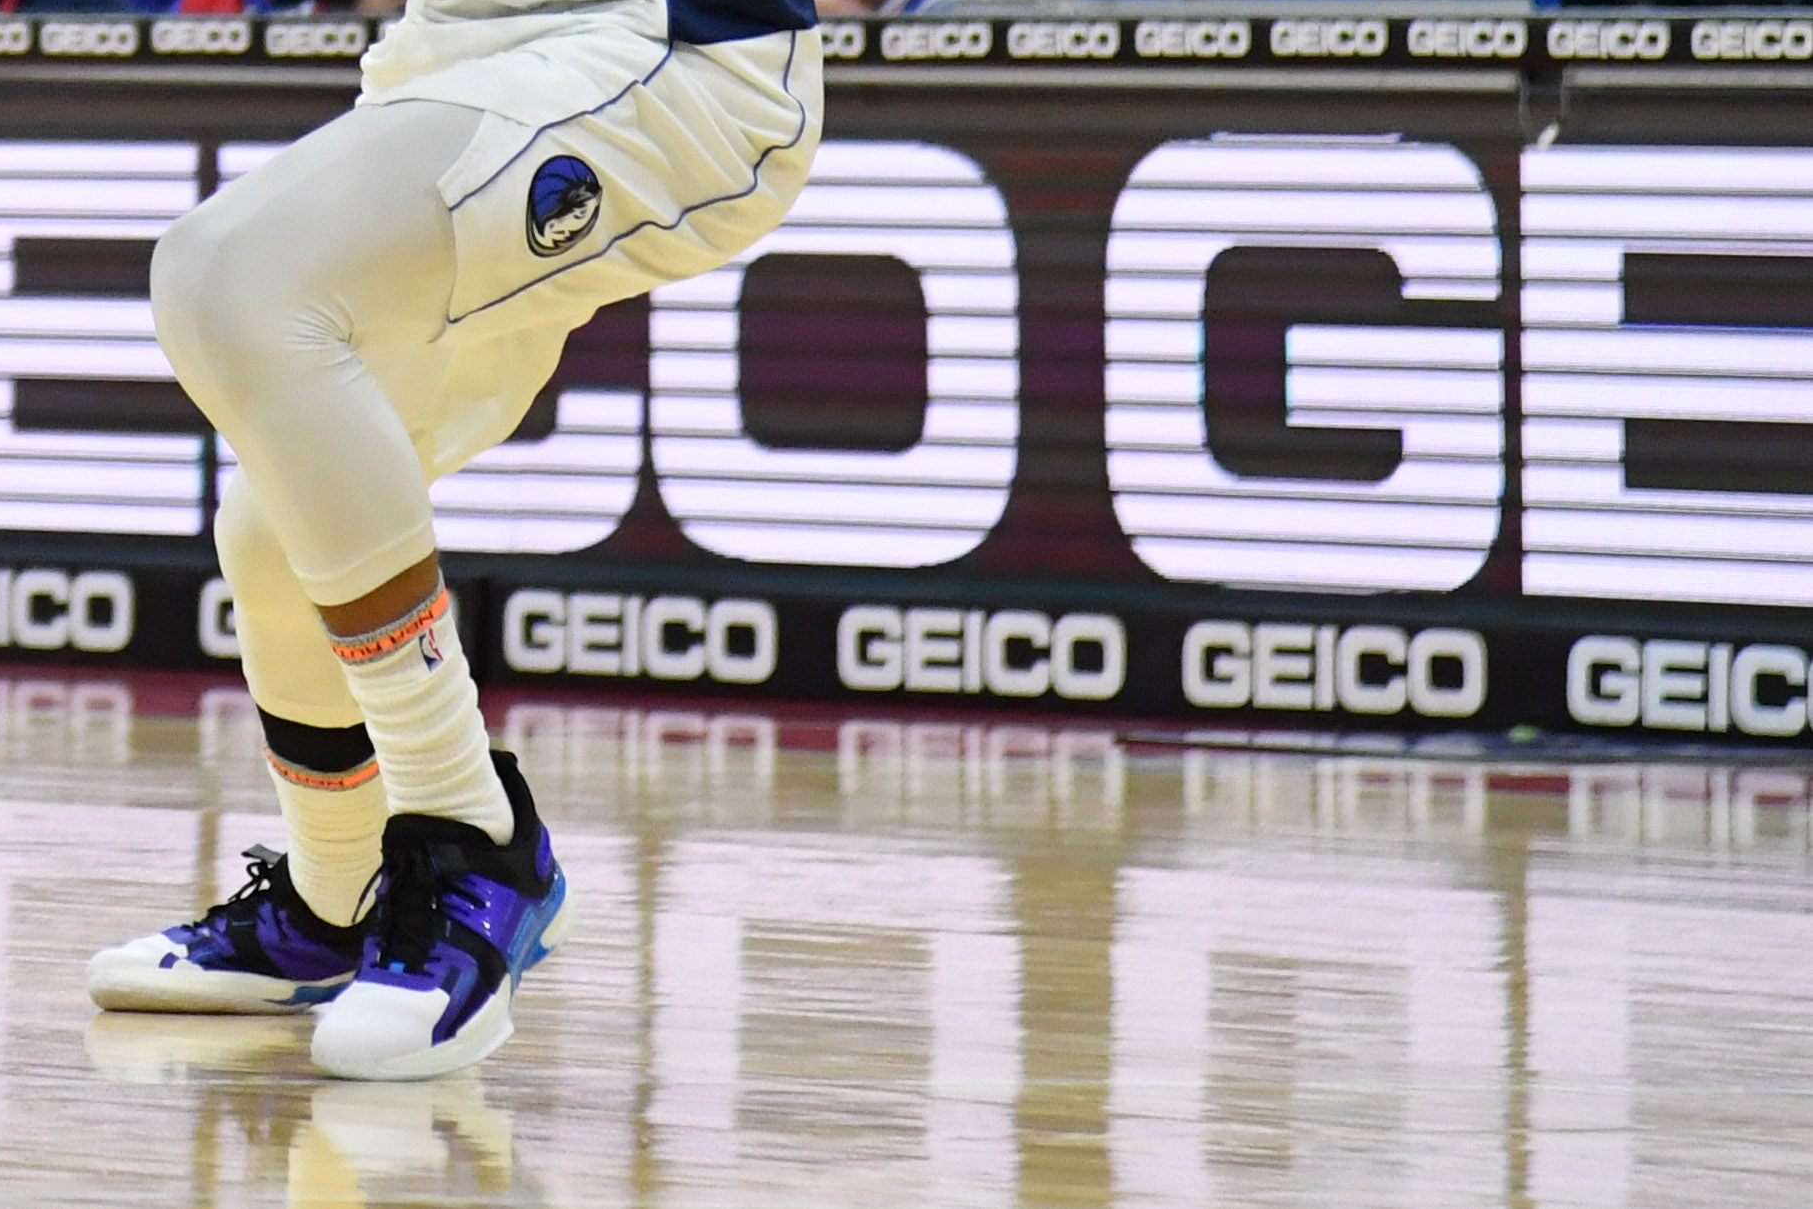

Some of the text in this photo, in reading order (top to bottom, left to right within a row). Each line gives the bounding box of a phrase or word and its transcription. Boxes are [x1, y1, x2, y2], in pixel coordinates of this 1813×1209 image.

[40, 22, 139, 58] GEICO
[151, 20, 251, 55] GEICO
[265, 22, 367, 58] GEICO
[881, 22, 992, 60] GEICO
[1007, 22, 1121, 59] GEICO
[1134, 21, 1252, 58] GEICO
[1269, 20, 1389, 57] GEICO
[1407, 20, 1528, 57] GEICO
[1547, 20, 1671, 59] GEICO
[1691, 20, 1813, 59] GEICO
[503, 588, 778, 683] GEICO
[837, 604, 1126, 701] GEICO
[1182, 619, 1488, 717] GEICO
[1566, 634, 1813, 738] GEIC
